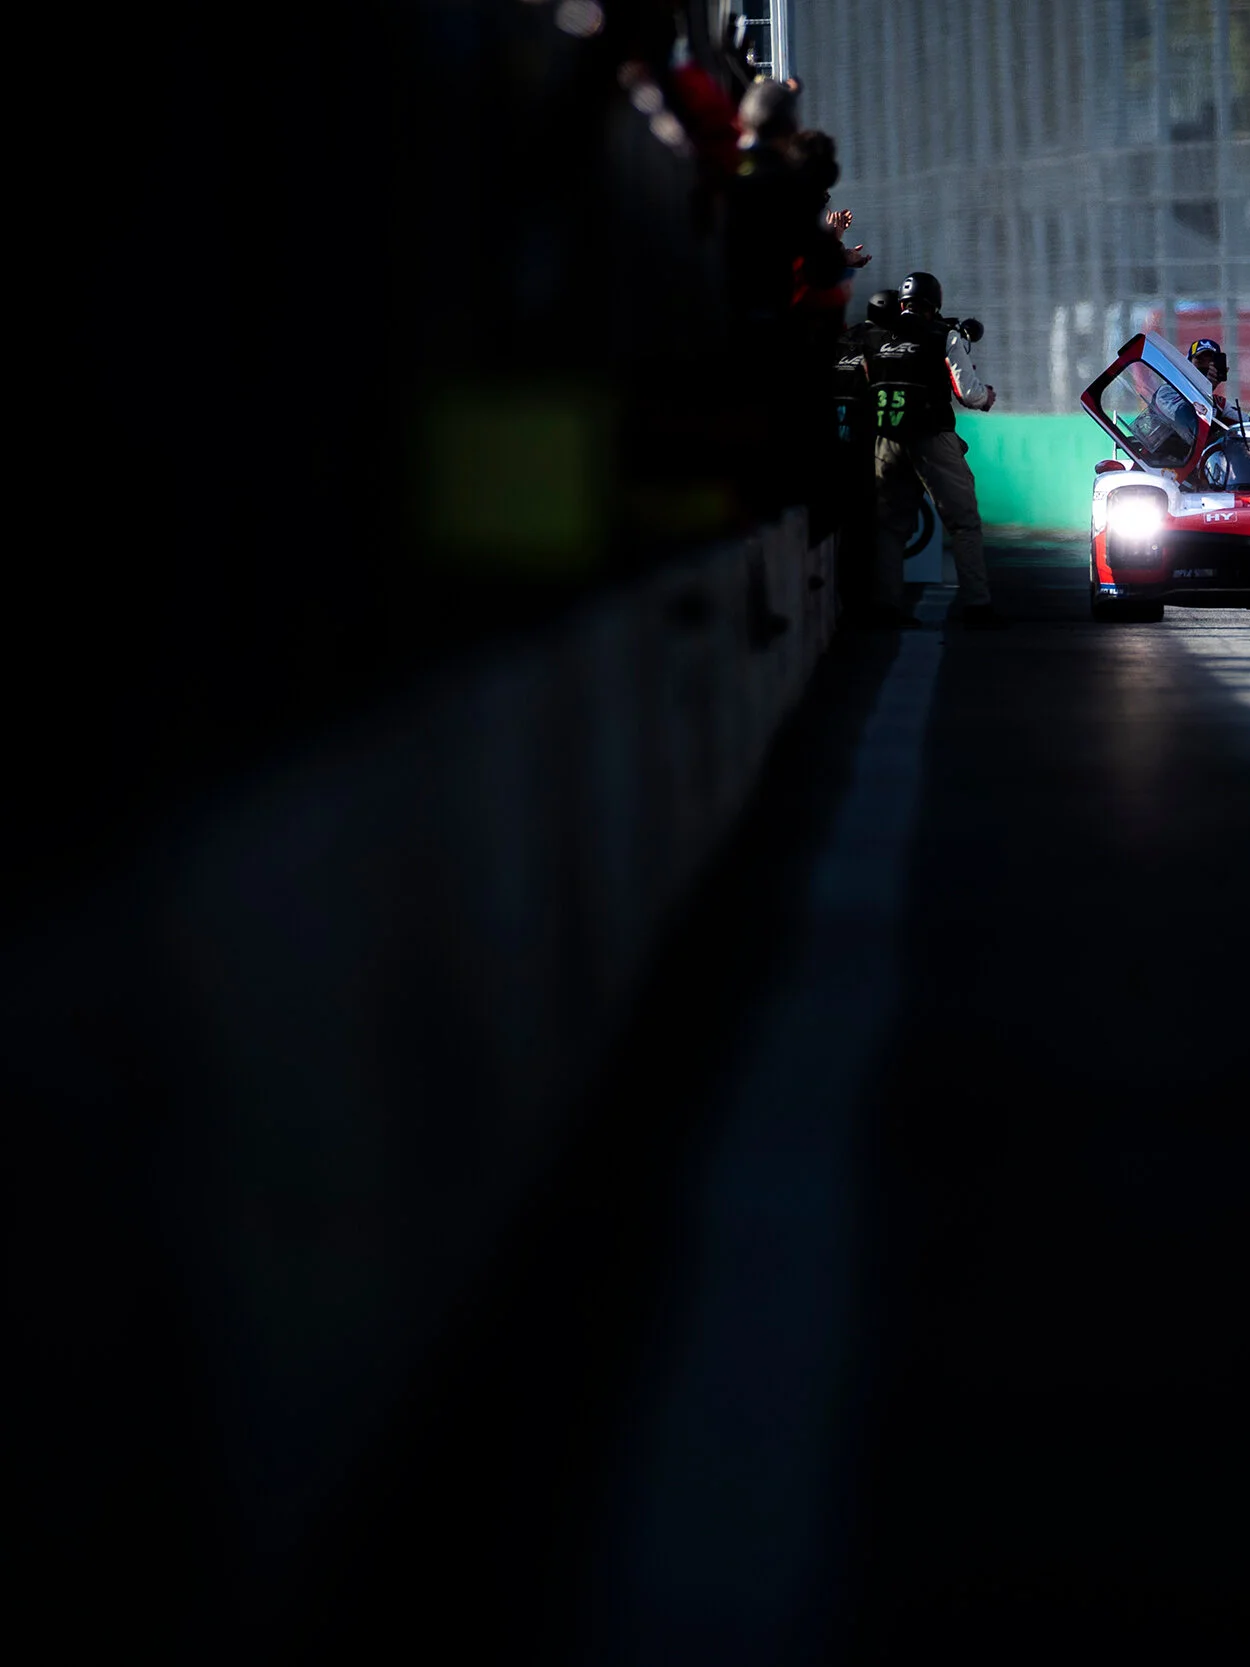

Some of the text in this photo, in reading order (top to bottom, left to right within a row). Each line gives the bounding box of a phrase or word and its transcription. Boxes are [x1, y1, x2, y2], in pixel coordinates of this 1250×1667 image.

[880, 342, 921, 354] WEC
[876, 389, 907, 409] 35
[876, 410, 906, 428] TV
[1206, 512, 1235, 522] HY
